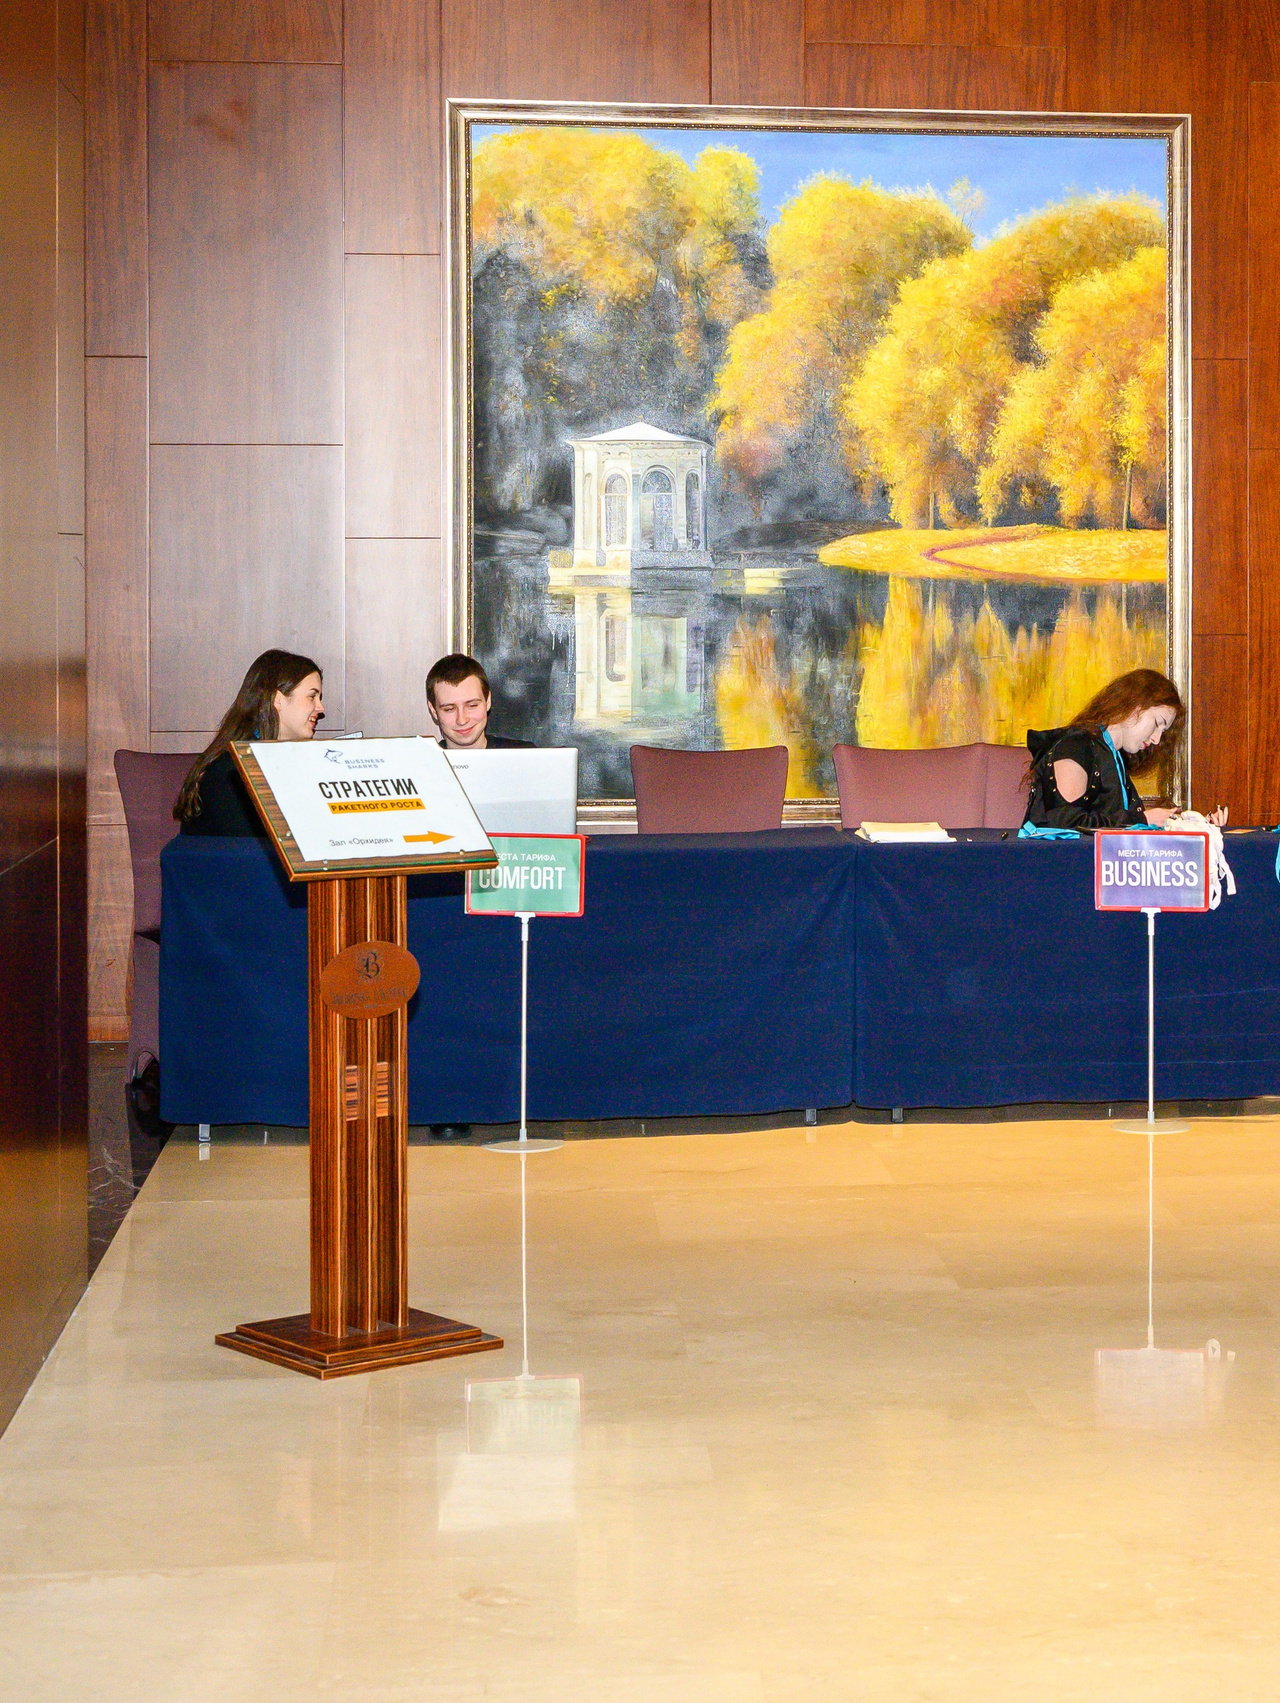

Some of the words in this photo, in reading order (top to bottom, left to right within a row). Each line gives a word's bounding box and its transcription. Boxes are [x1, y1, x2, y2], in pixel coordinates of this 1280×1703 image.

[318, 778, 418, 799] СТРАТЕГИИ
[330, 802, 388, 811] РАКЕТНОГО
[390, 801, 422, 809] РОСТА
[348, 837, 393, 846] «Орхидея»
[521, 853, 557, 862] ТАРИФА
[1117, 850, 1147, 858] МЕСТА
[1148, 849, 1183, 858] ТАРИФА
[478, 866, 566, 890] COMFORT
[1101, 861, 1198, 887] BUSINESS
